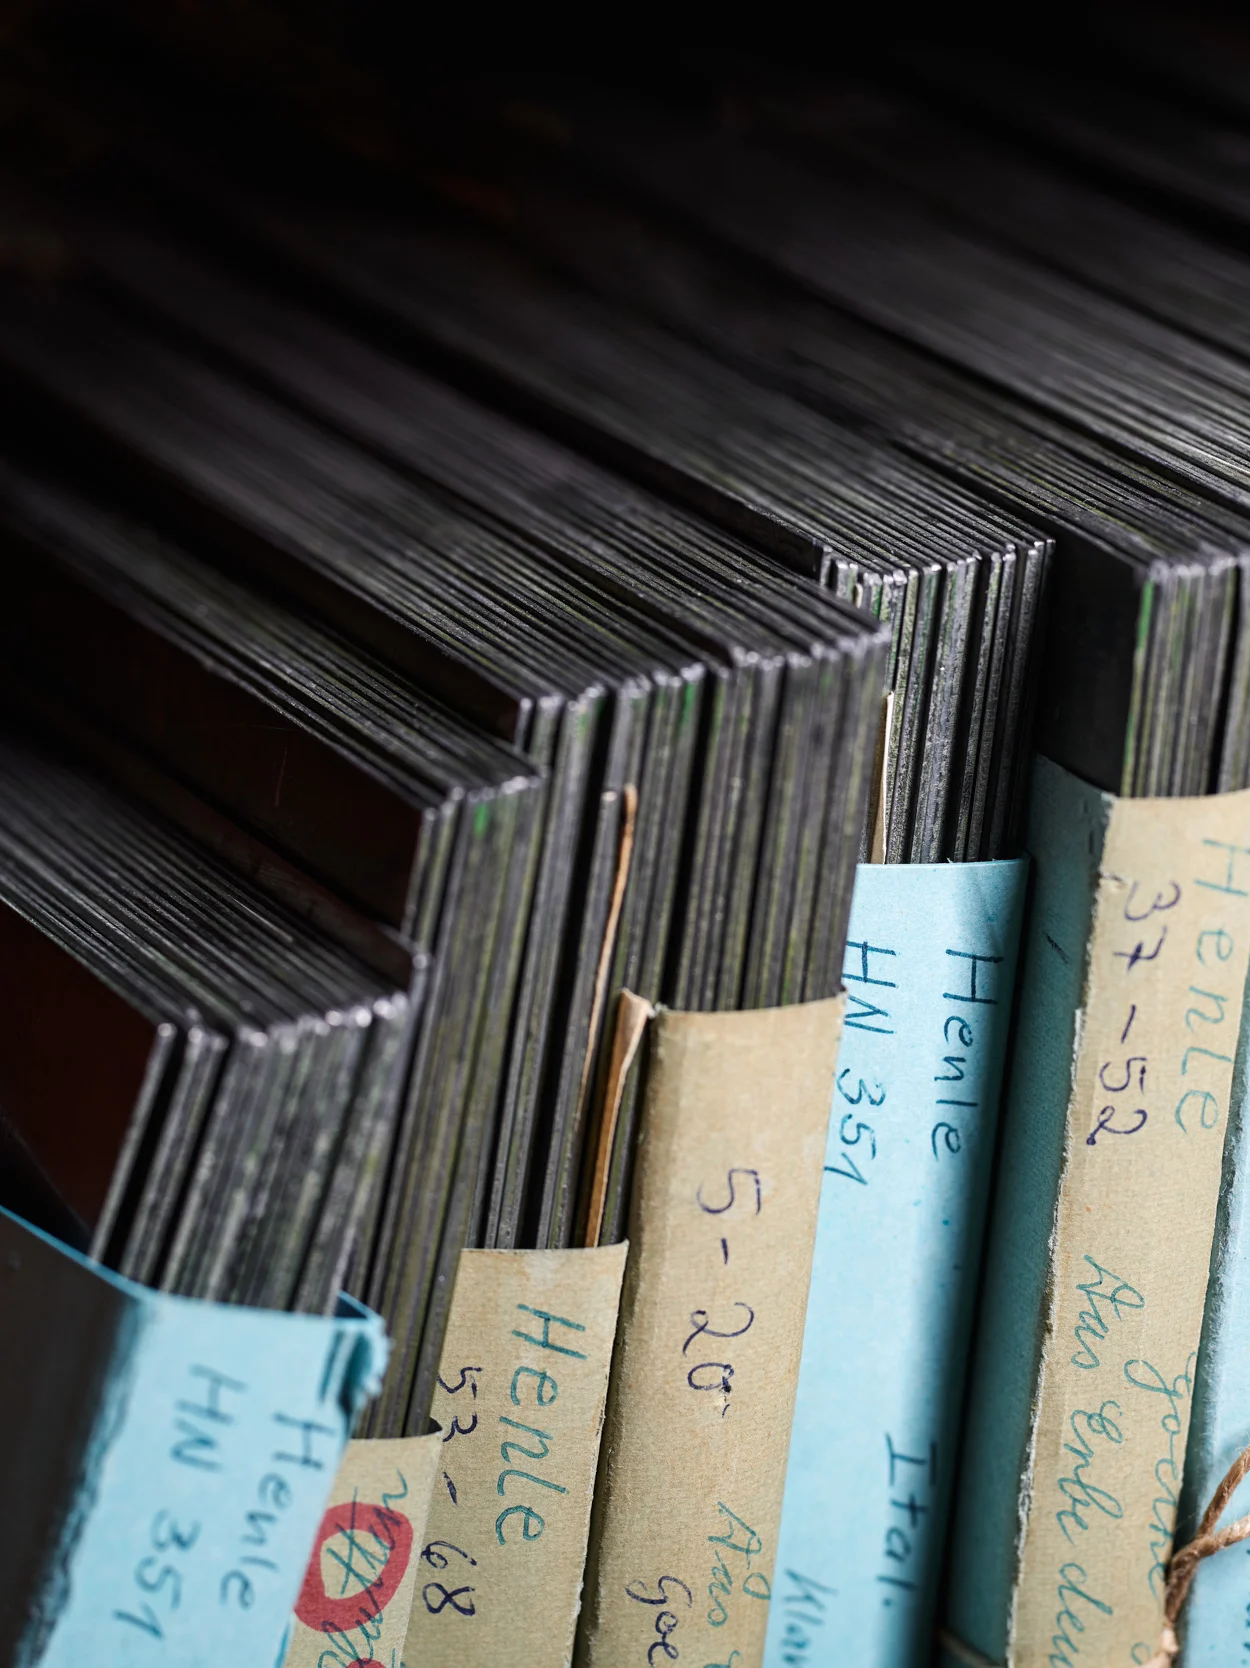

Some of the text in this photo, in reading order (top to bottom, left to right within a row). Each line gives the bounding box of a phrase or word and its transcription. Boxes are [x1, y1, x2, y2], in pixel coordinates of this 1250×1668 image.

[824, 939, 897, 1185] HN 351
[931, 948, 1004, 1160] Henle
[113, 1364, 247, 1638] HN 351
[220, 1411, 335, 1610] Henle
[495, 1304, 588, 1545] Henle
